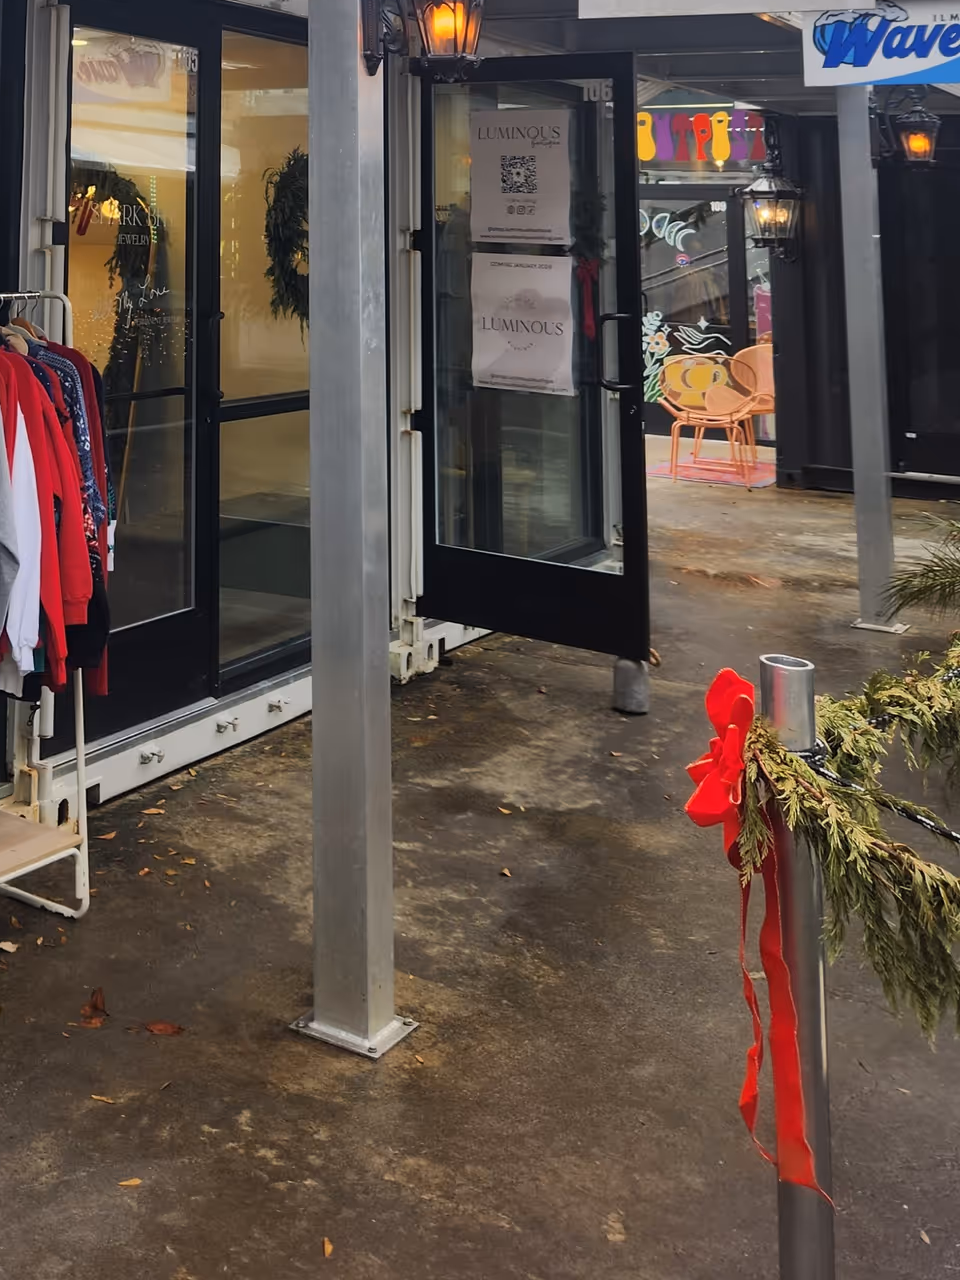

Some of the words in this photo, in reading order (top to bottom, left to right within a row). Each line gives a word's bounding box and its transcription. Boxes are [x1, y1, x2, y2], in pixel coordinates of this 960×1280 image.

[582, 81, 613, 102] 106
[478, 125, 561, 140] LUMINOUS
[710, 200, 727, 213] 109
[482, 316, 564, 336] LUMINOUS
